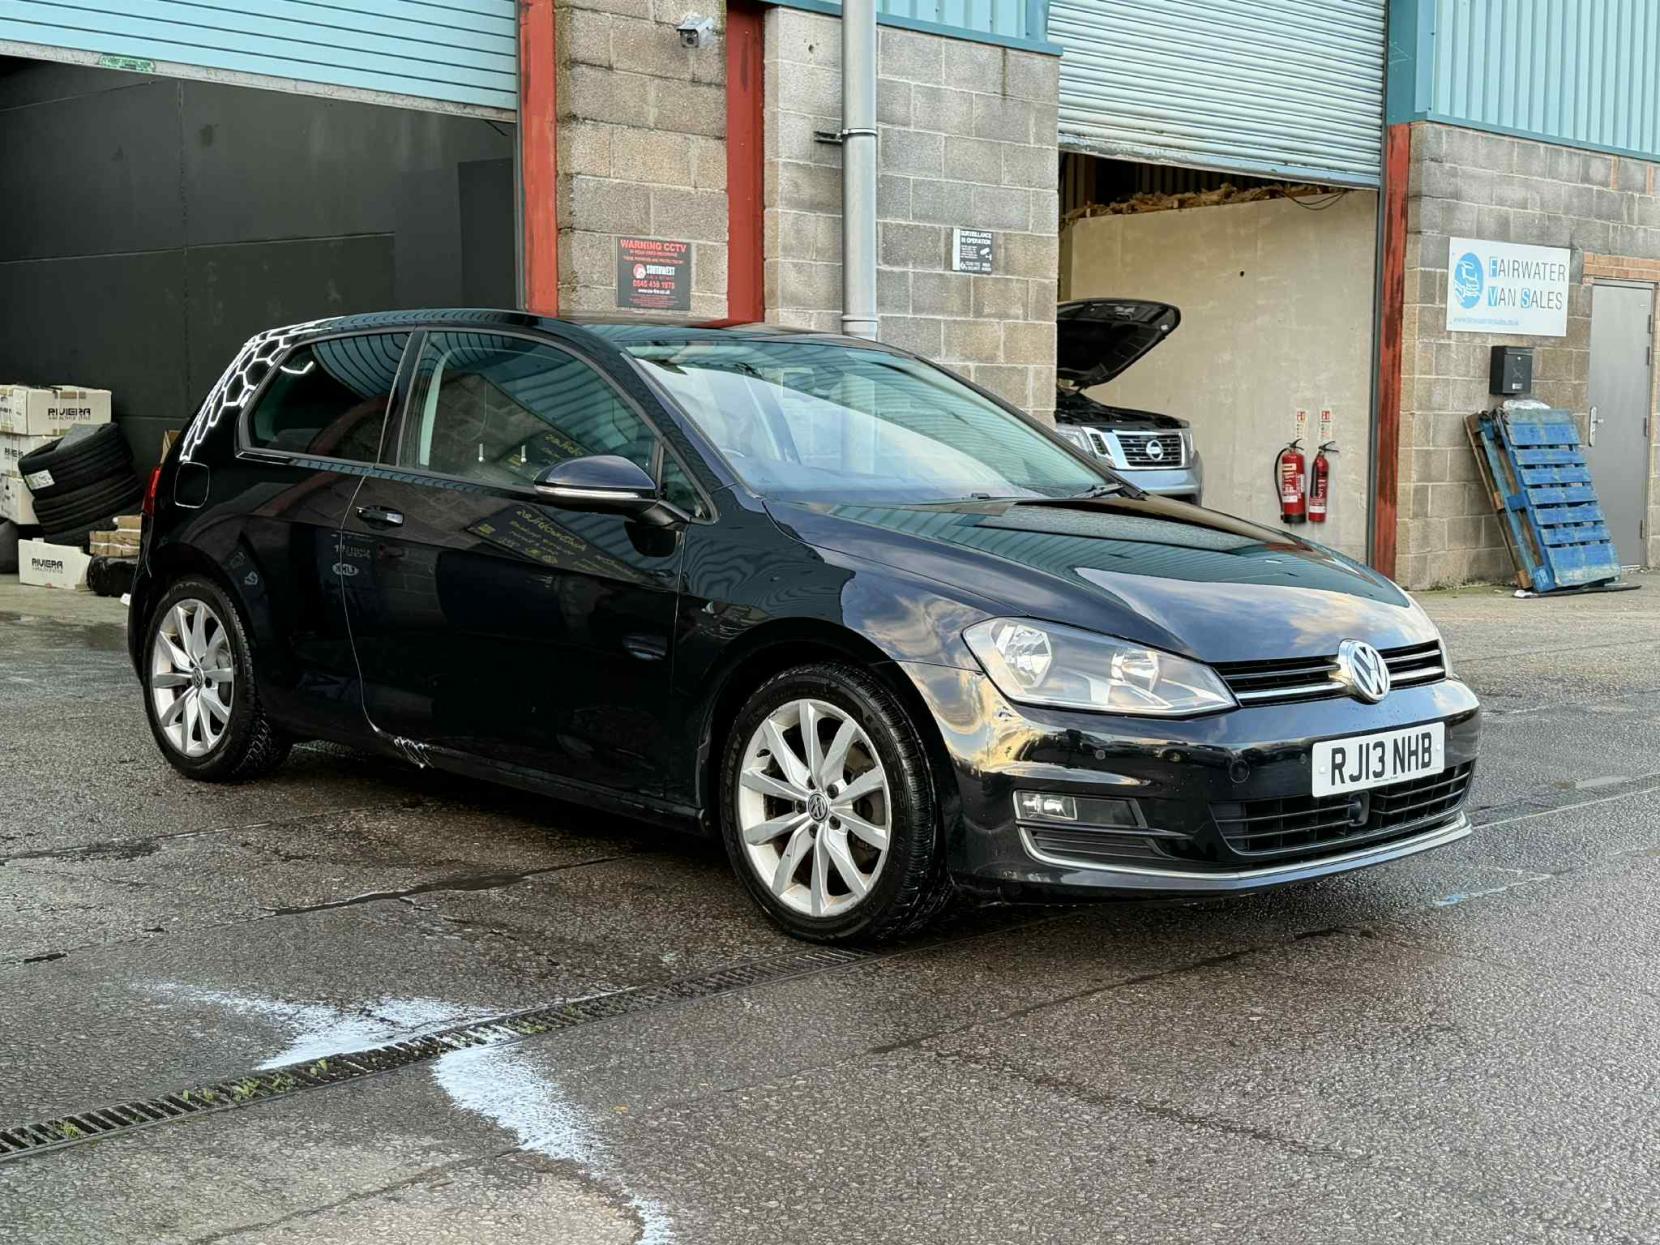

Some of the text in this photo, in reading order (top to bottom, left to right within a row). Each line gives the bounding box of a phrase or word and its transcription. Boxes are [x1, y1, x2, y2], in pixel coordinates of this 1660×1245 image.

[620, 239, 687, 253] WARNING CCTV
[1488, 256, 1566, 282] FAIRWATER
[1488, 286, 1563, 310] VAN SALES
[48, 407, 91, 416] RIVIERA
[31, 558, 64, 569] RIVIERA
[1330, 732, 1432, 787] RJ13 NHB
